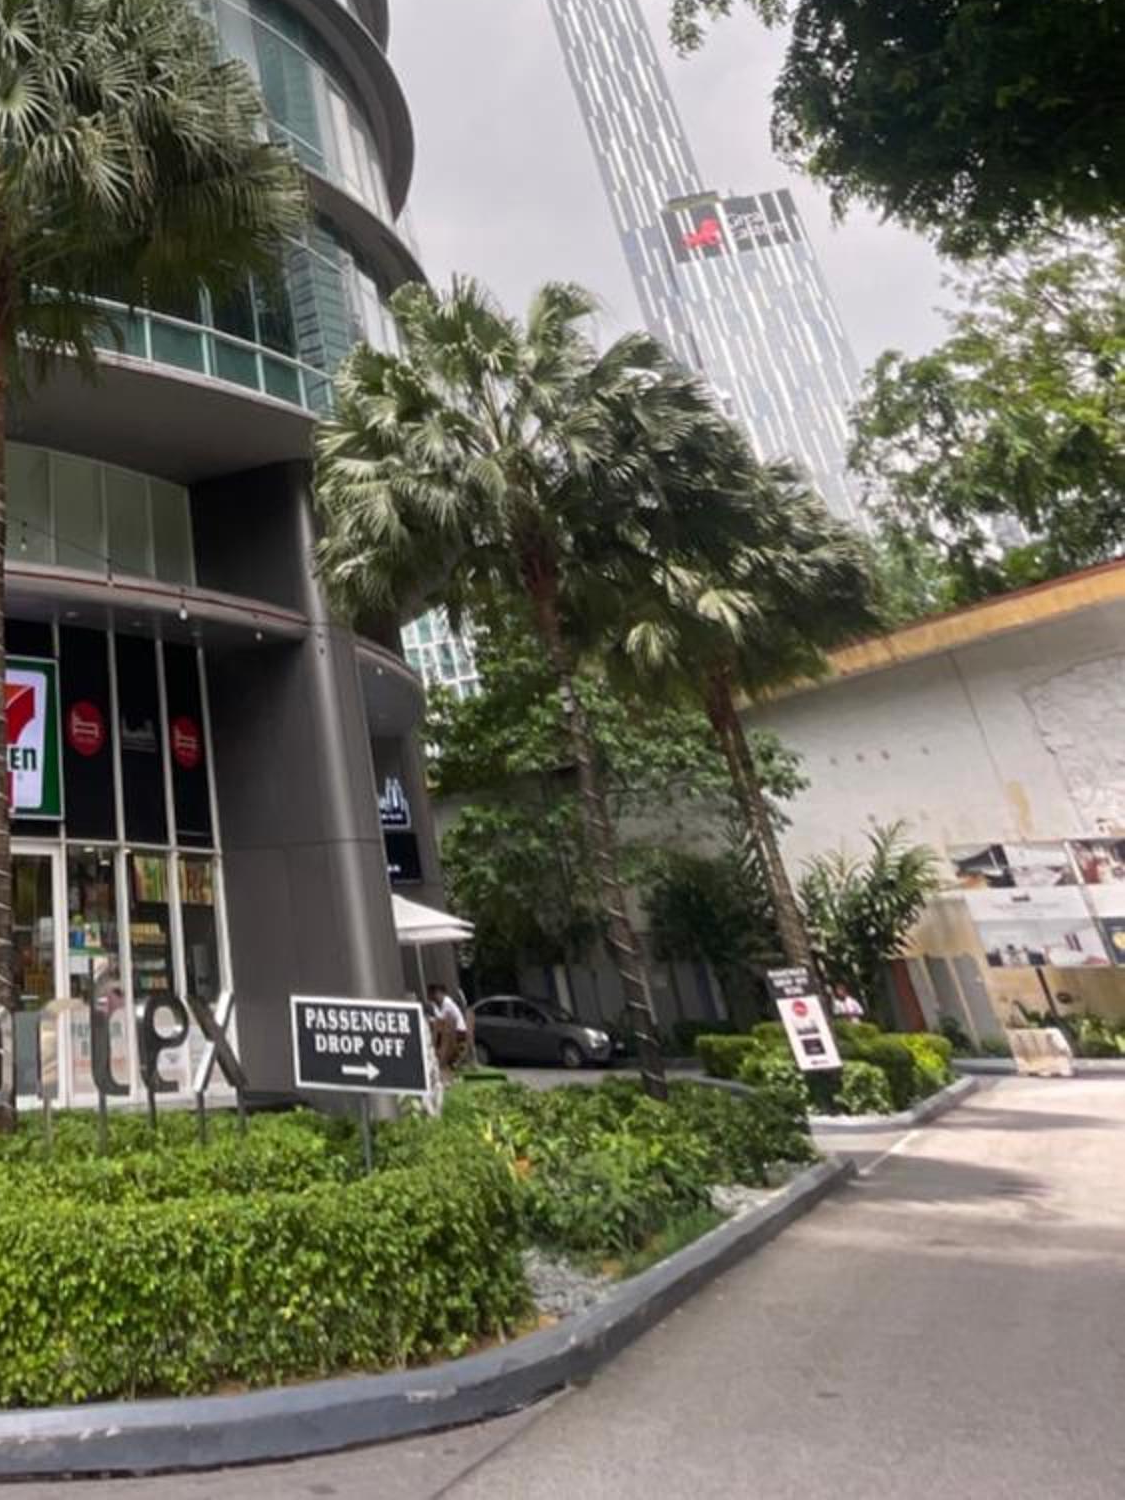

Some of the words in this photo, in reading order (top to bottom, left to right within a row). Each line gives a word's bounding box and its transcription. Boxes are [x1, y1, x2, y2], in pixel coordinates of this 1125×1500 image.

[304, 1007, 411, 1034] PASSENGER
[314, 1033, 364, 1054] DROP
[371, 1037, 405, 1057] OFF
